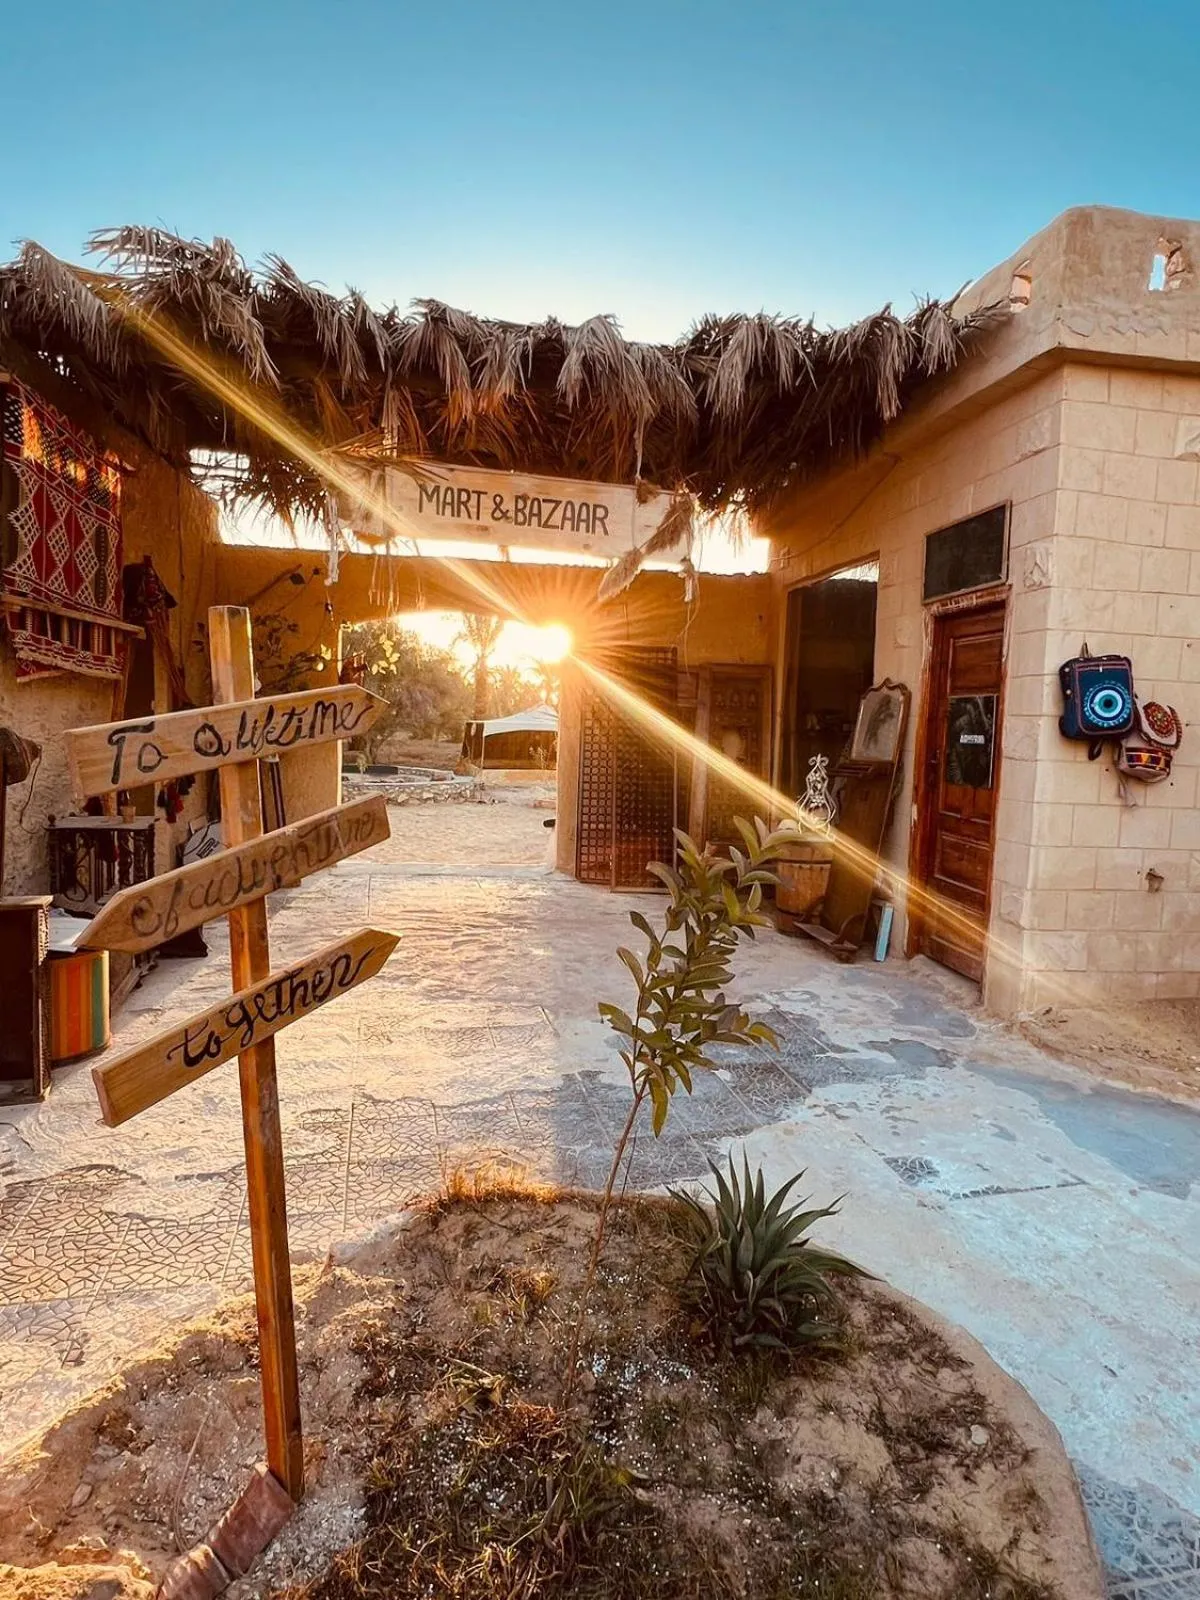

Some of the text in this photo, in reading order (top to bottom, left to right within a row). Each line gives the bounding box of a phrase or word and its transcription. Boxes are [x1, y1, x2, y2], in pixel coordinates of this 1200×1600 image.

[418, 484, 610, 536] MART & BAZAAR
[108, 721, 168, 784] To
